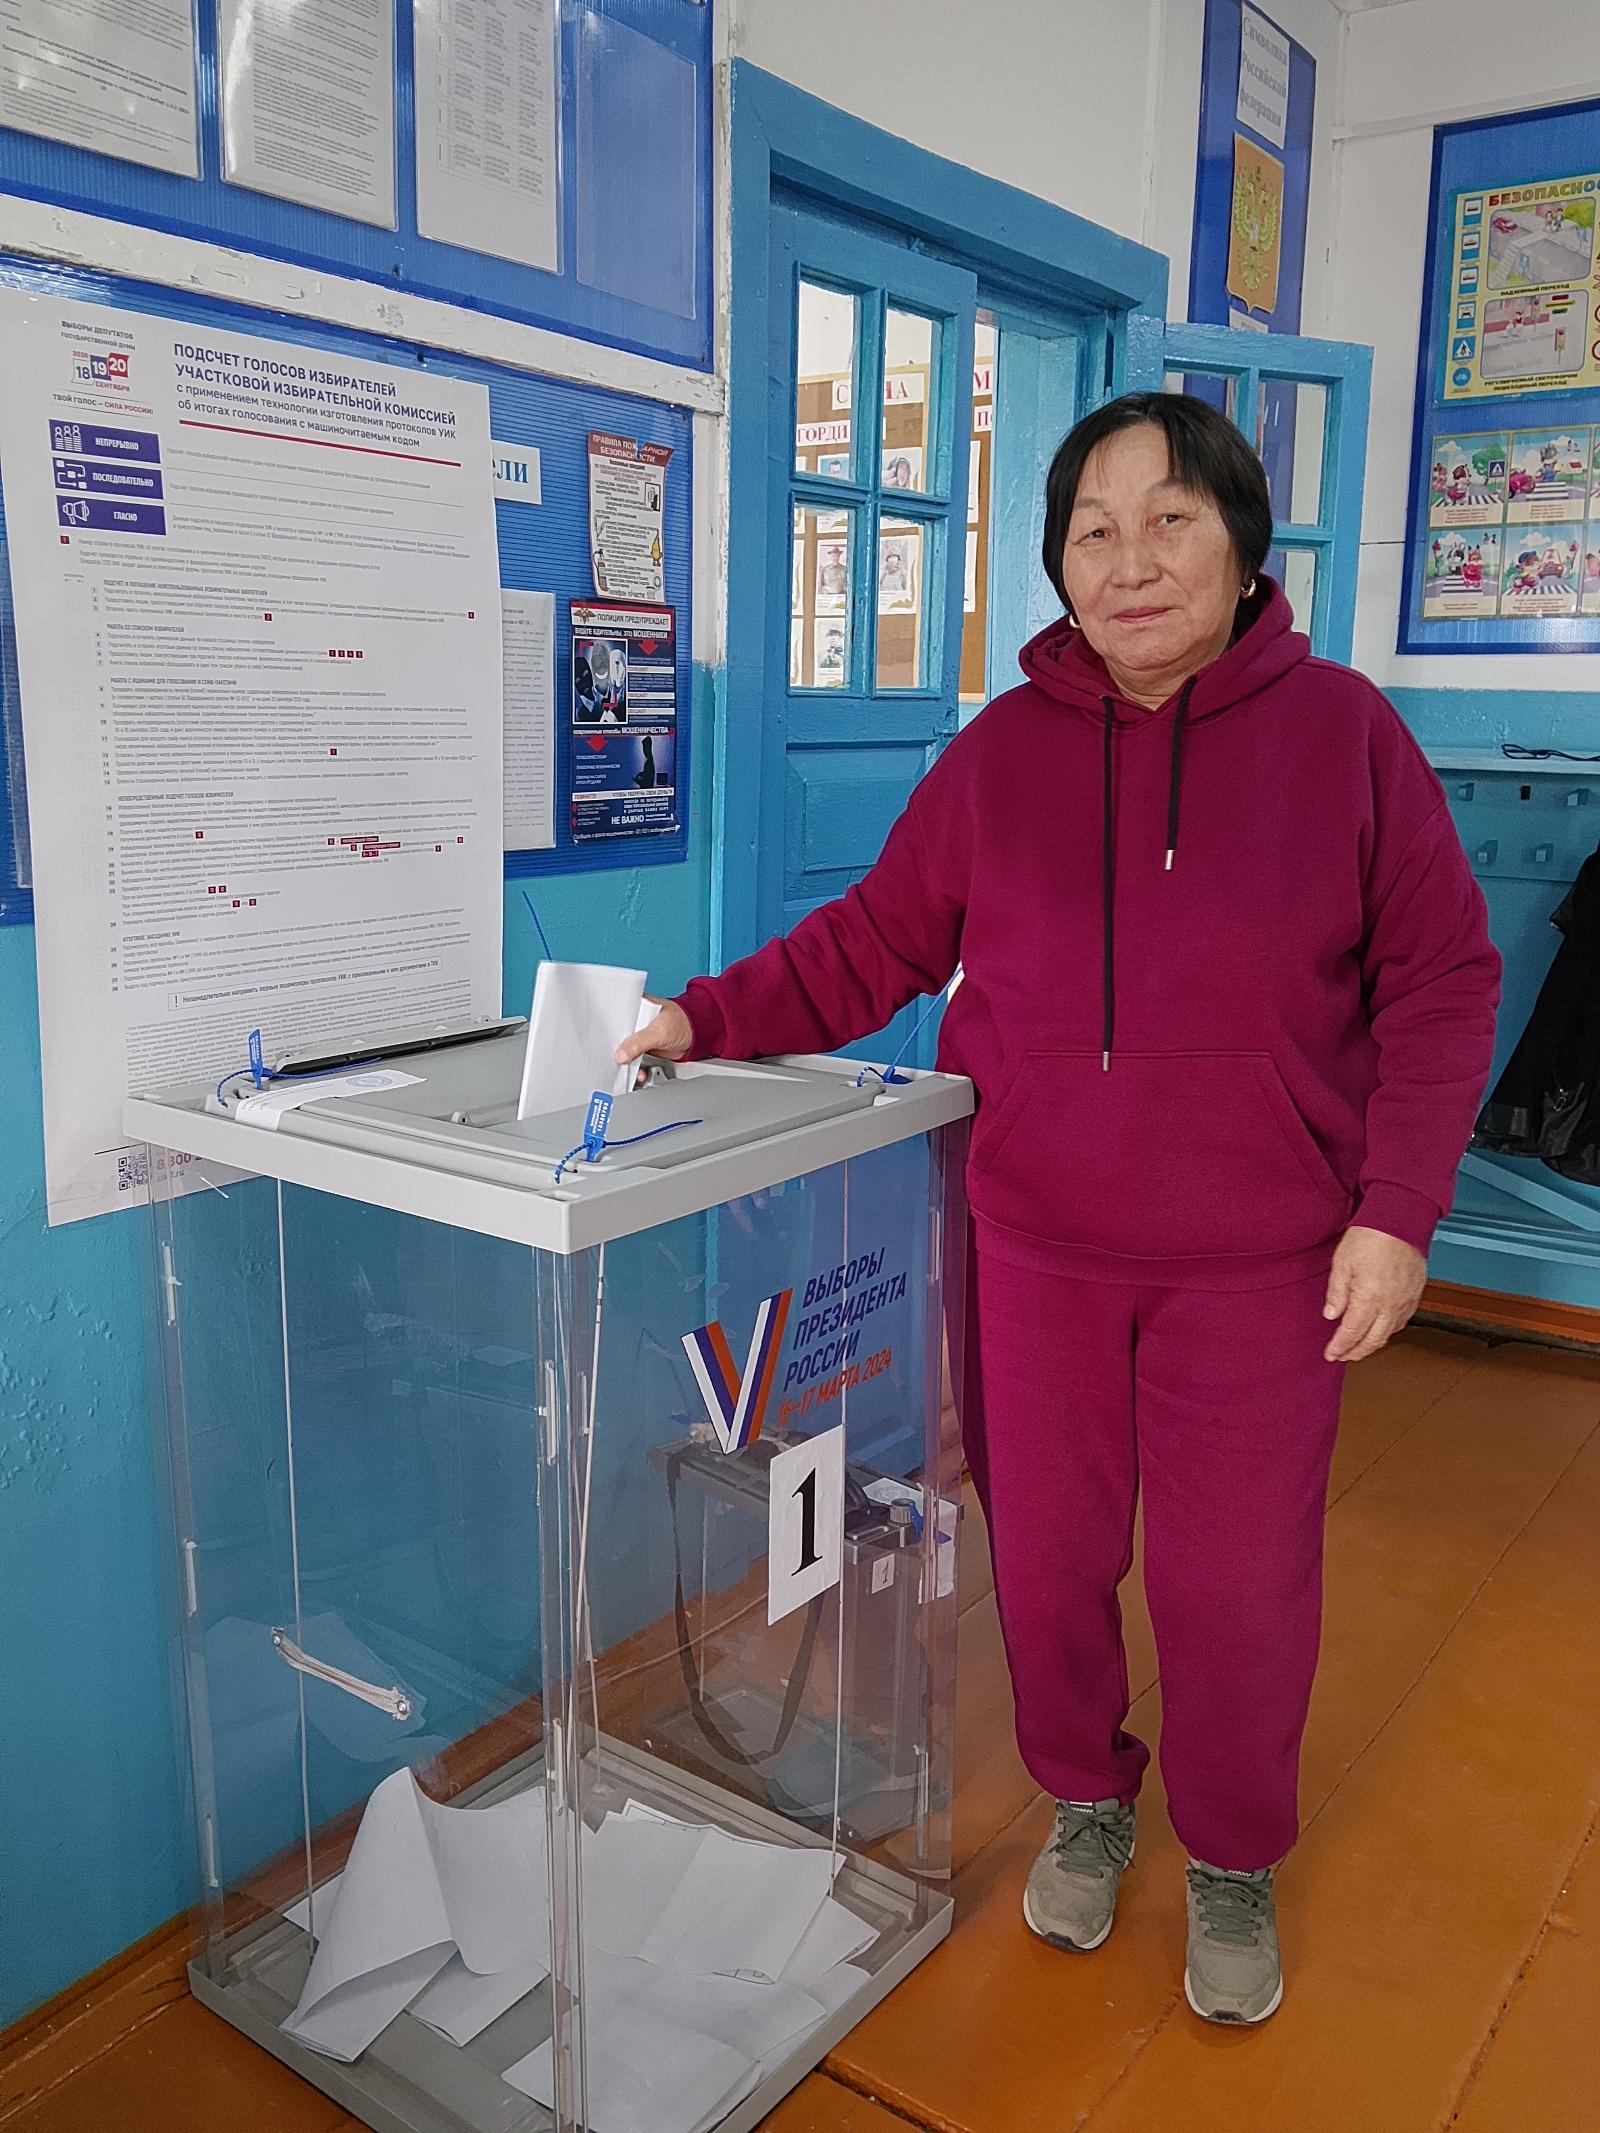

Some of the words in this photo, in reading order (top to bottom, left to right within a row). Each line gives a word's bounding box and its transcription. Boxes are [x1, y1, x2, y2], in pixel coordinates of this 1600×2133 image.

[1244, 16, 1287, 66] Символика
[1242, 50, 1286, 98] Российской
[62, 320, 92, 332] ВЫБОРЫ
[94, 327, 133, 339] ДЕПУТАТОВ
[61, 332, 118, 346] ГОСУДАРСТВЕННОЙ
[76, 366, 91, 379] 18
[92, 361, 107, 375] 19
[109, 358, 126, 372] 20
[174, 343, 240, 367] ПОДСЧЕТ
[244, 356, 305, 380] ГОЛОСОВ
[309, 369, 396, 397] ИЗБИРАТЕЛЕЙ
[96, 381, 130, 392] СЕНТЯБРЯ
[175, 363, 270, 392] УЧАСТКОВОЙ
[274, 381, 381, 412] ИЗБИРАТЕЛЬНОЙ
[385, 402, 456, 426] КОМИССИЕЙ
[837, 380, 908, 404] СНА
[53, 393, 72, 402] ТВОЙ
[73, 396, 96, 406] ГОЛОС
[104, 401, 122, 410] СИЛА
[177, 384, 183, 393] с
[186, 386, 259, 406] применением
[260, 398, 318, 416] технологии
[320, 410, 384, 427] изготовления
[386, 420, 436, 436] протоколов
[438, 428, 456, 439] УИК
[178, 400, 192, 410] об
[194, 402, 230, 416] итогах
[233, 409, 297, 427] голосования
[300, 420, 305, 428] с
[308, 422, 390, 442] машиночитаемым
[392, 435, 420, 447] кодом
[592, 434, 621, 447] ПРАВИЛА
[798, 424, 849, 442] ГОРДИ
[95, 437, 139, 451] НЕПРЕРЫВНО
[92, 472, 154, 487] ПОСЛЕДОВАТЕЛЬНО
[113, 512, 138, 522] ГЛАСНО
[597, 614, 624, 622] ПОЛИЦИЯ
[624, 616, 669, 626] ПРЕДУПРЕЖДАЕТ
[633, 631, 668, 639] МОШЕННИКИ
[622, 726, 669, 734] МОШЕННИЧЕСТВА
[611, 816, 620, 825] НЕ
[621, 815, 644, 824] ВАЖНО
[802, 1246, 886, 1308] ВЫБОРЫ
[793, 1272, 907, 1350] ПРЕЗИДЕНТА
[784, 1329, 860, 1392] РОССИИ
[816, 1368, 860, 1406] МАРТА
[862, 1345, 892, 1382] 2024
[791, 1466, 823, 1577] 1
[882, 1560, 889, 1584] 1
